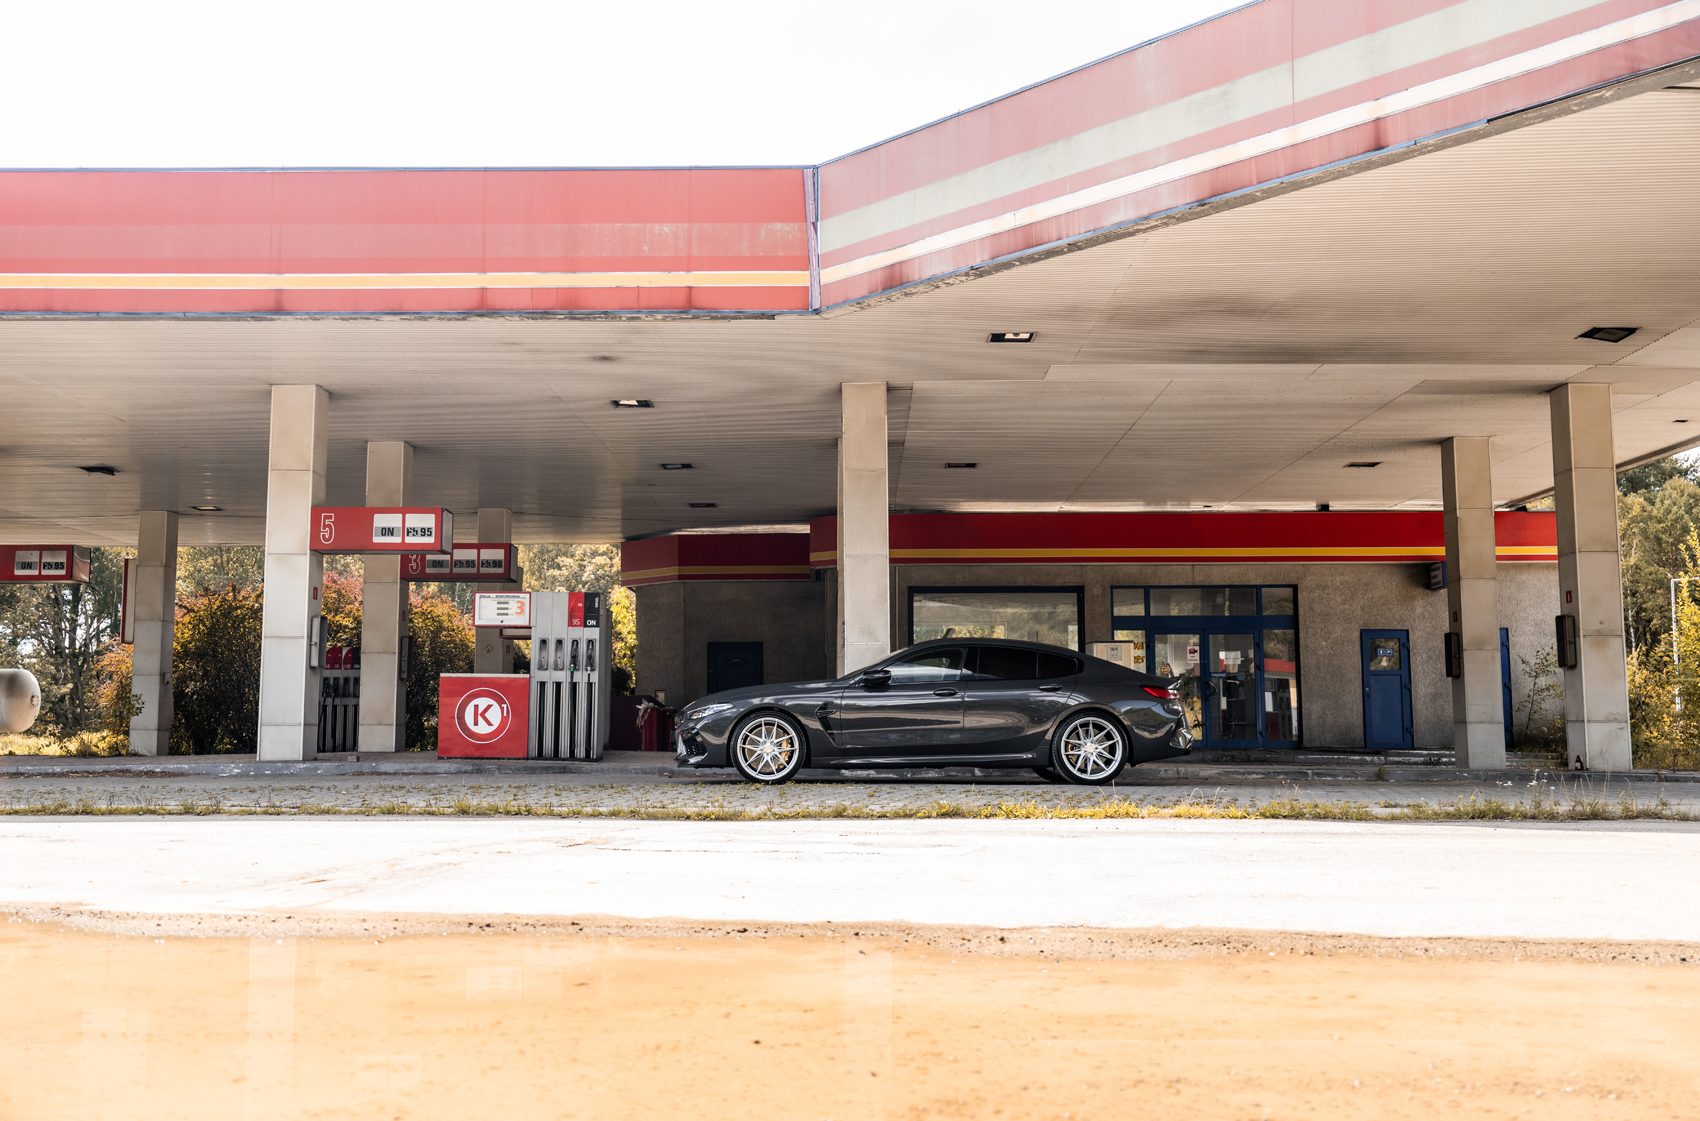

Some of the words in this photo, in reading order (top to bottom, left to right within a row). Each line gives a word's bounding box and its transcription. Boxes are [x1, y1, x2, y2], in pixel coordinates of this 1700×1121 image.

[320, 513, 335, 544] 5
[380, 527, 395, 537] ON
[420, 527, 432, 537] 95
[432, 560, 443, 568] ON
[465, 560, 476, 568] 95
[492, 560, 503, 568] 98
[514, 600, 525, 615] 3
[473, 704, 494, 727] K
